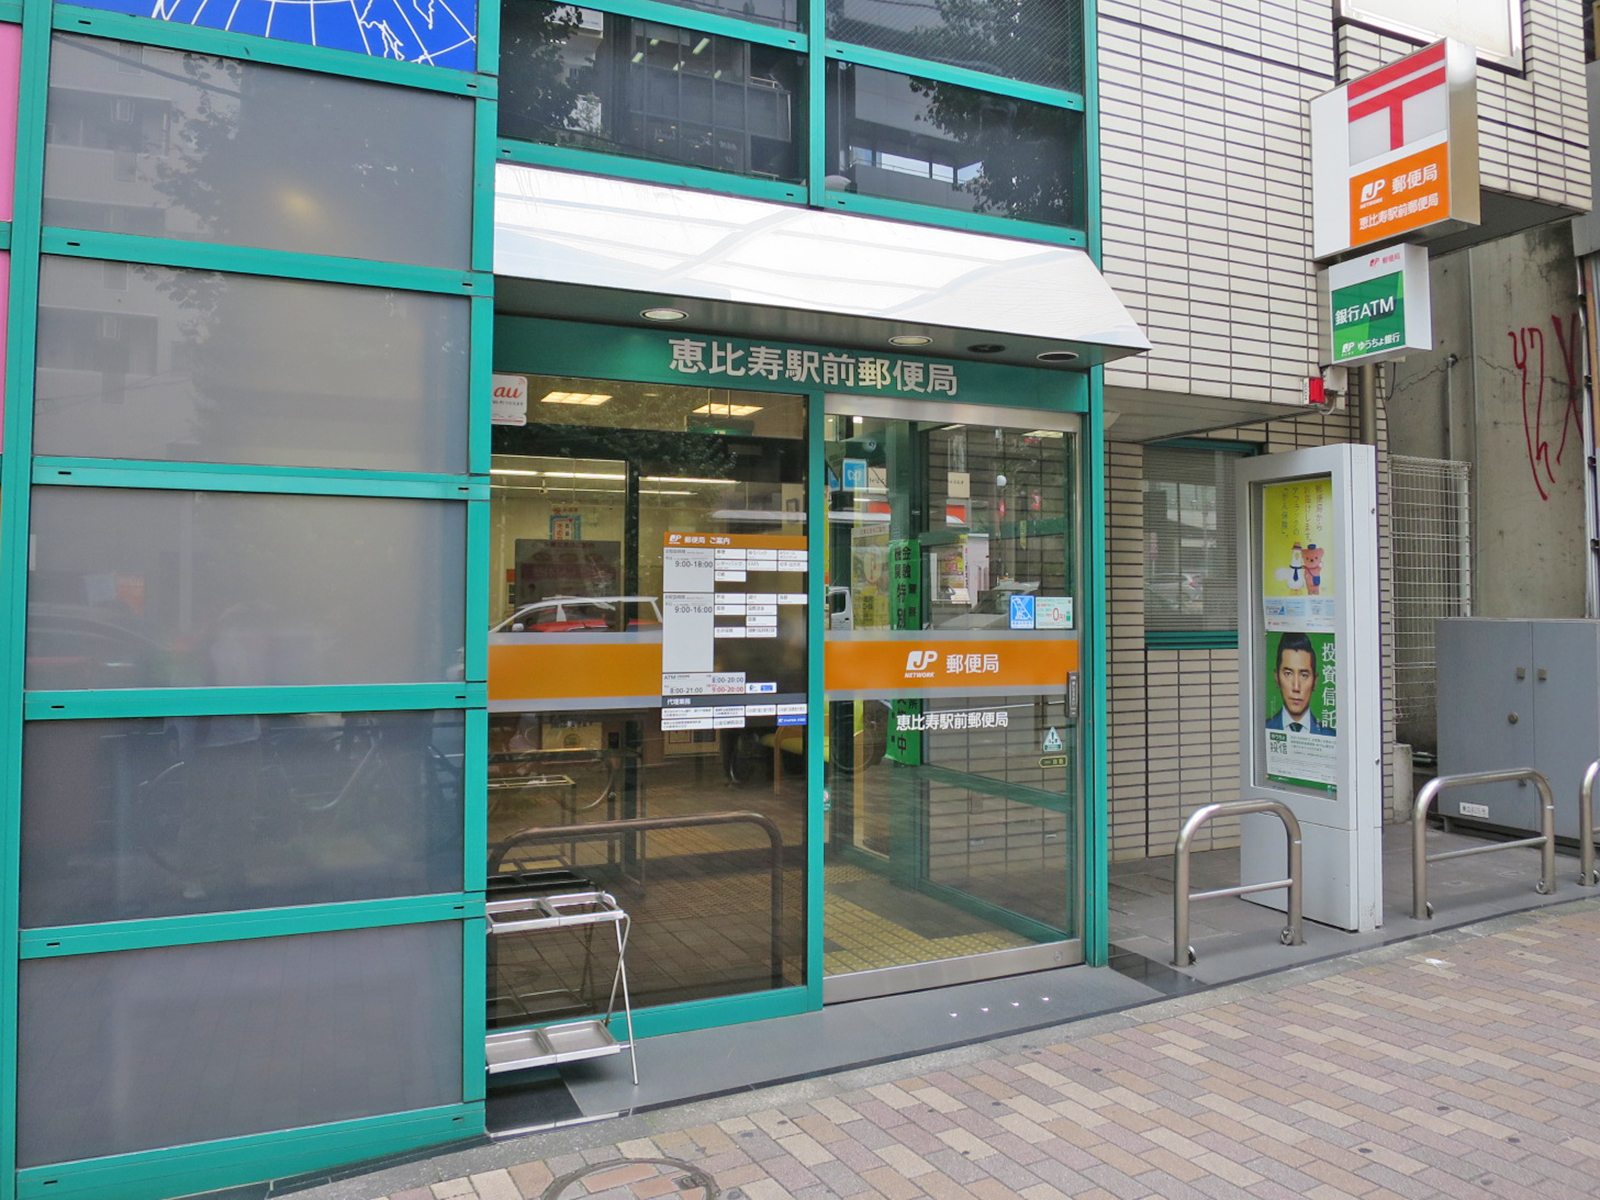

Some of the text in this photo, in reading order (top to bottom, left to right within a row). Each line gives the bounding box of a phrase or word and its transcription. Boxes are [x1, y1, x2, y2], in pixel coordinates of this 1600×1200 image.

[1391, 163, 1439, 195] 郵便局
[1359, 192, 1440, 231] 恵比寿駅前郵便局
[1334, 295, 1395, 326] 銀行ATM
[1357, 332, 1401, 352] ゆうちょ銀行
[668, 337, 958, 396] 恵比寿駅前郵便局
[493, 386, 523, 399] au
[675, 606, 713, 614] 9:00-16:00
[946, 653, 999, 674] 郵便局
[896, 711, 1009, 731] 恵比寿駅前郵便局
[1270, 742, 1288, 755] 投信
